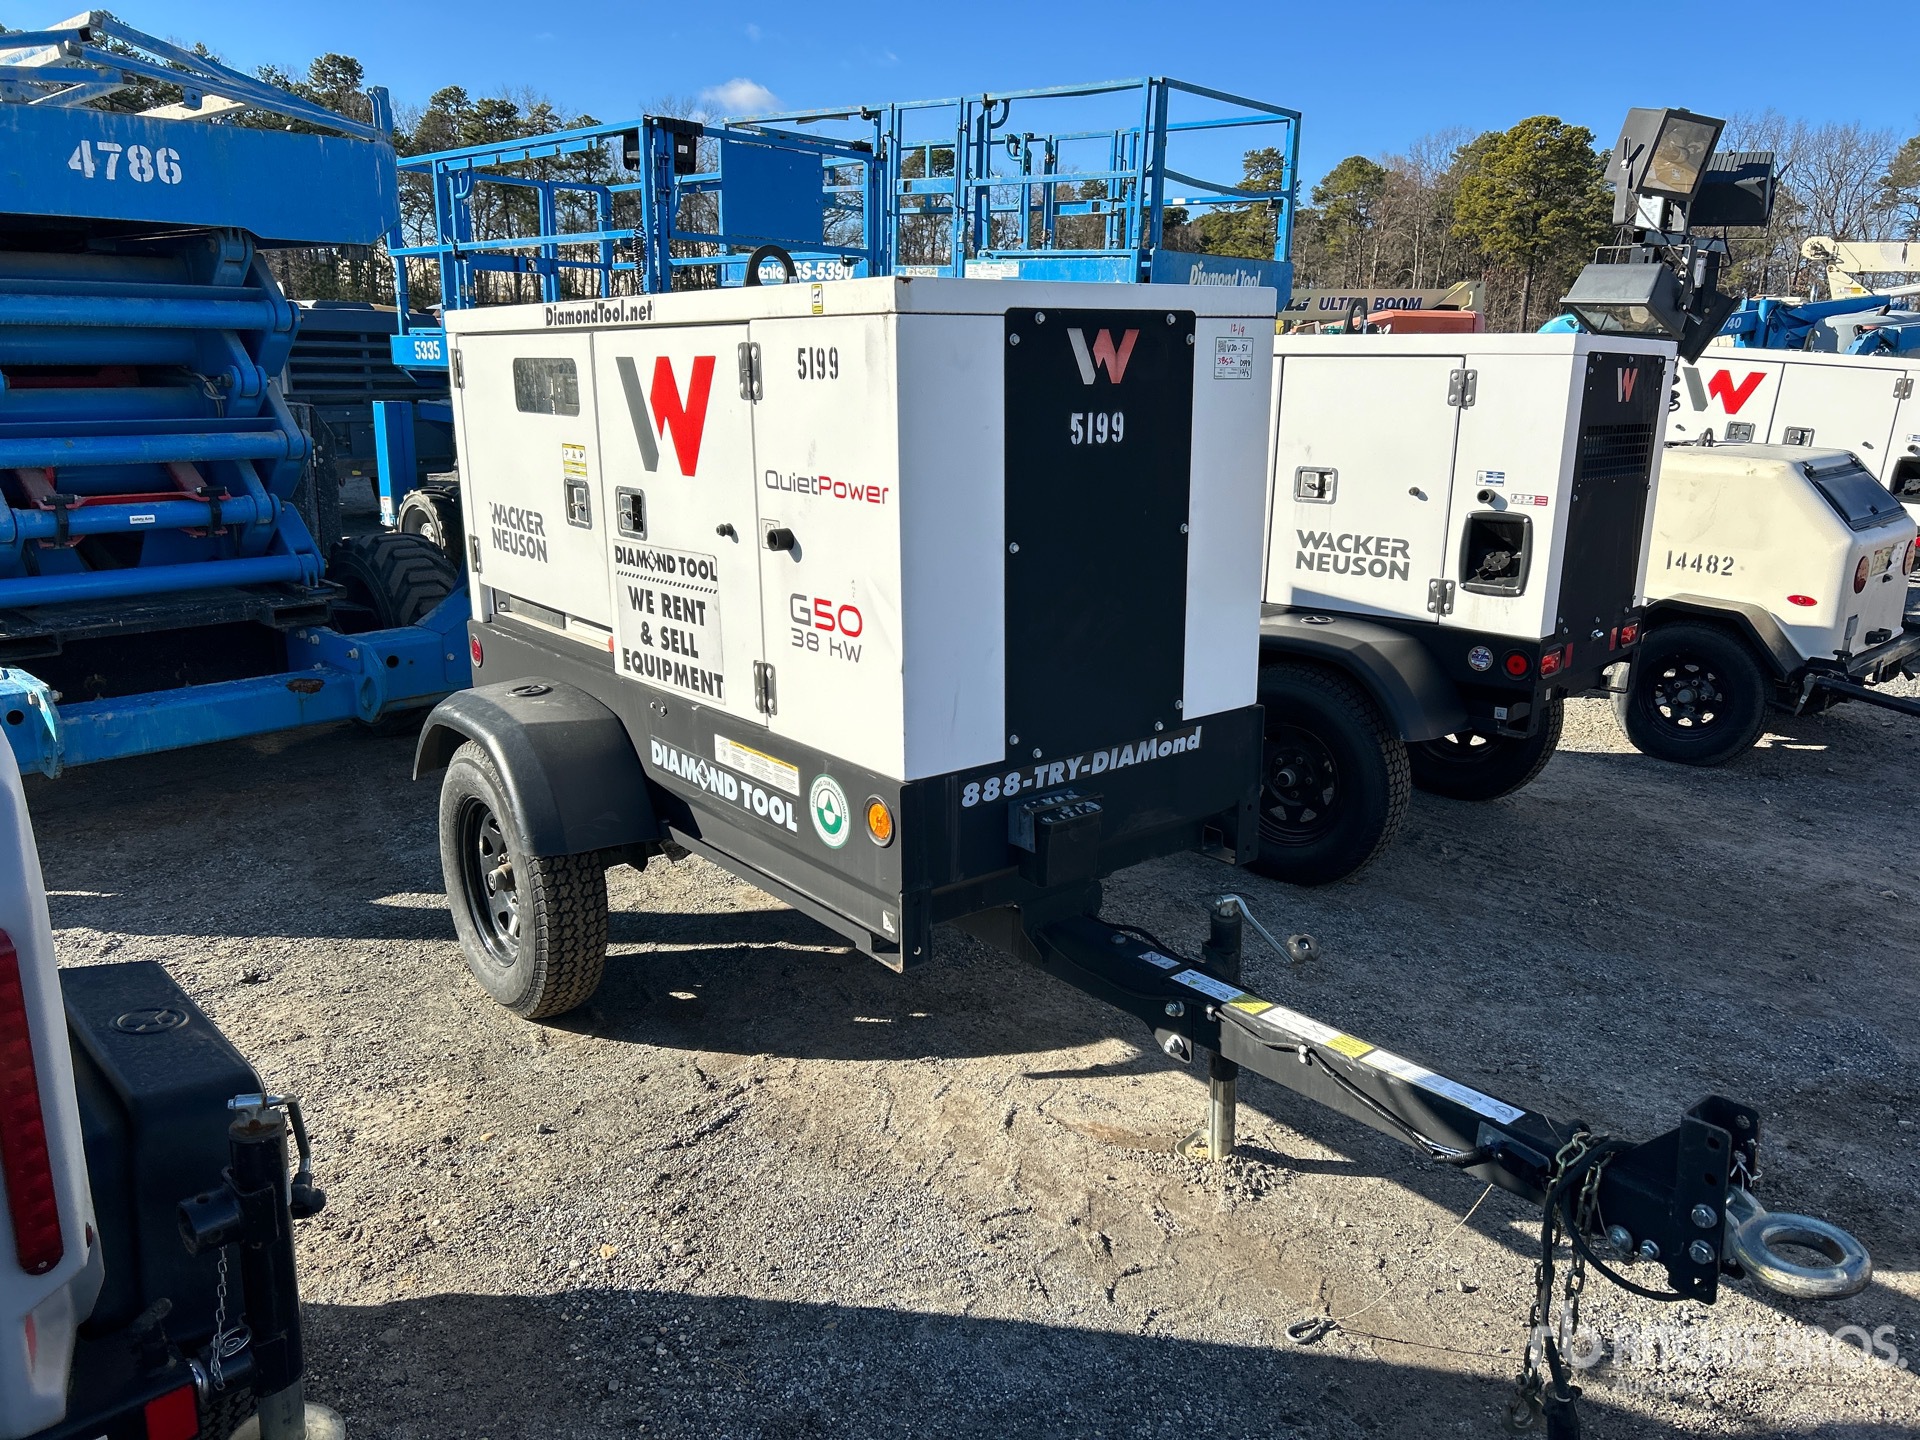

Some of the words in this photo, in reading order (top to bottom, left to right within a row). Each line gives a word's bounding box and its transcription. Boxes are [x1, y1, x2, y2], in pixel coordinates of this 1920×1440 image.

[67, 139, 182, 185] 4786
[757, 262, 786, 280] enie
[792, 261, 854, 280] GS-5390
[1189, 260, 1239, 287] Diamond
[1240, 269, 1261, 287] Tool
[545, 299, 653, 327] DiamondTool.net
[1372, 297, 1423, 311] BOOM
[414, 340, 440, 360] 5335
[797, 346, 839, 380] 5199
[1070, 411, 1124, 445] 5199
[765, 469, 889, 504] QuietPower
[489, 501, 546, 538] WACKER
[492, 526, 548, 564] NEUSON
[1296, 529, 1411, 559] WACKER
[614, 544, 676, 574] DIAMOND
[678, 556, 718, 582] TOOL
[1296, 550, 1411, 581] NEUSON
[1666, 549, 1736, 577] 14482
[627, 585, 655, 615] WE
[660, 592, 706, 627] RENT
[790, 592, 863, 638] G50
[640, 620, 655, 648] &
[660, 625, 700, 659] SELL
[791, 626, 820, 653] 38
[622, 647, 724, 699] EQUIPMENT
[650, 739, 739, 802] DIAMOND
[740, 780, 798, 833] TOOL
